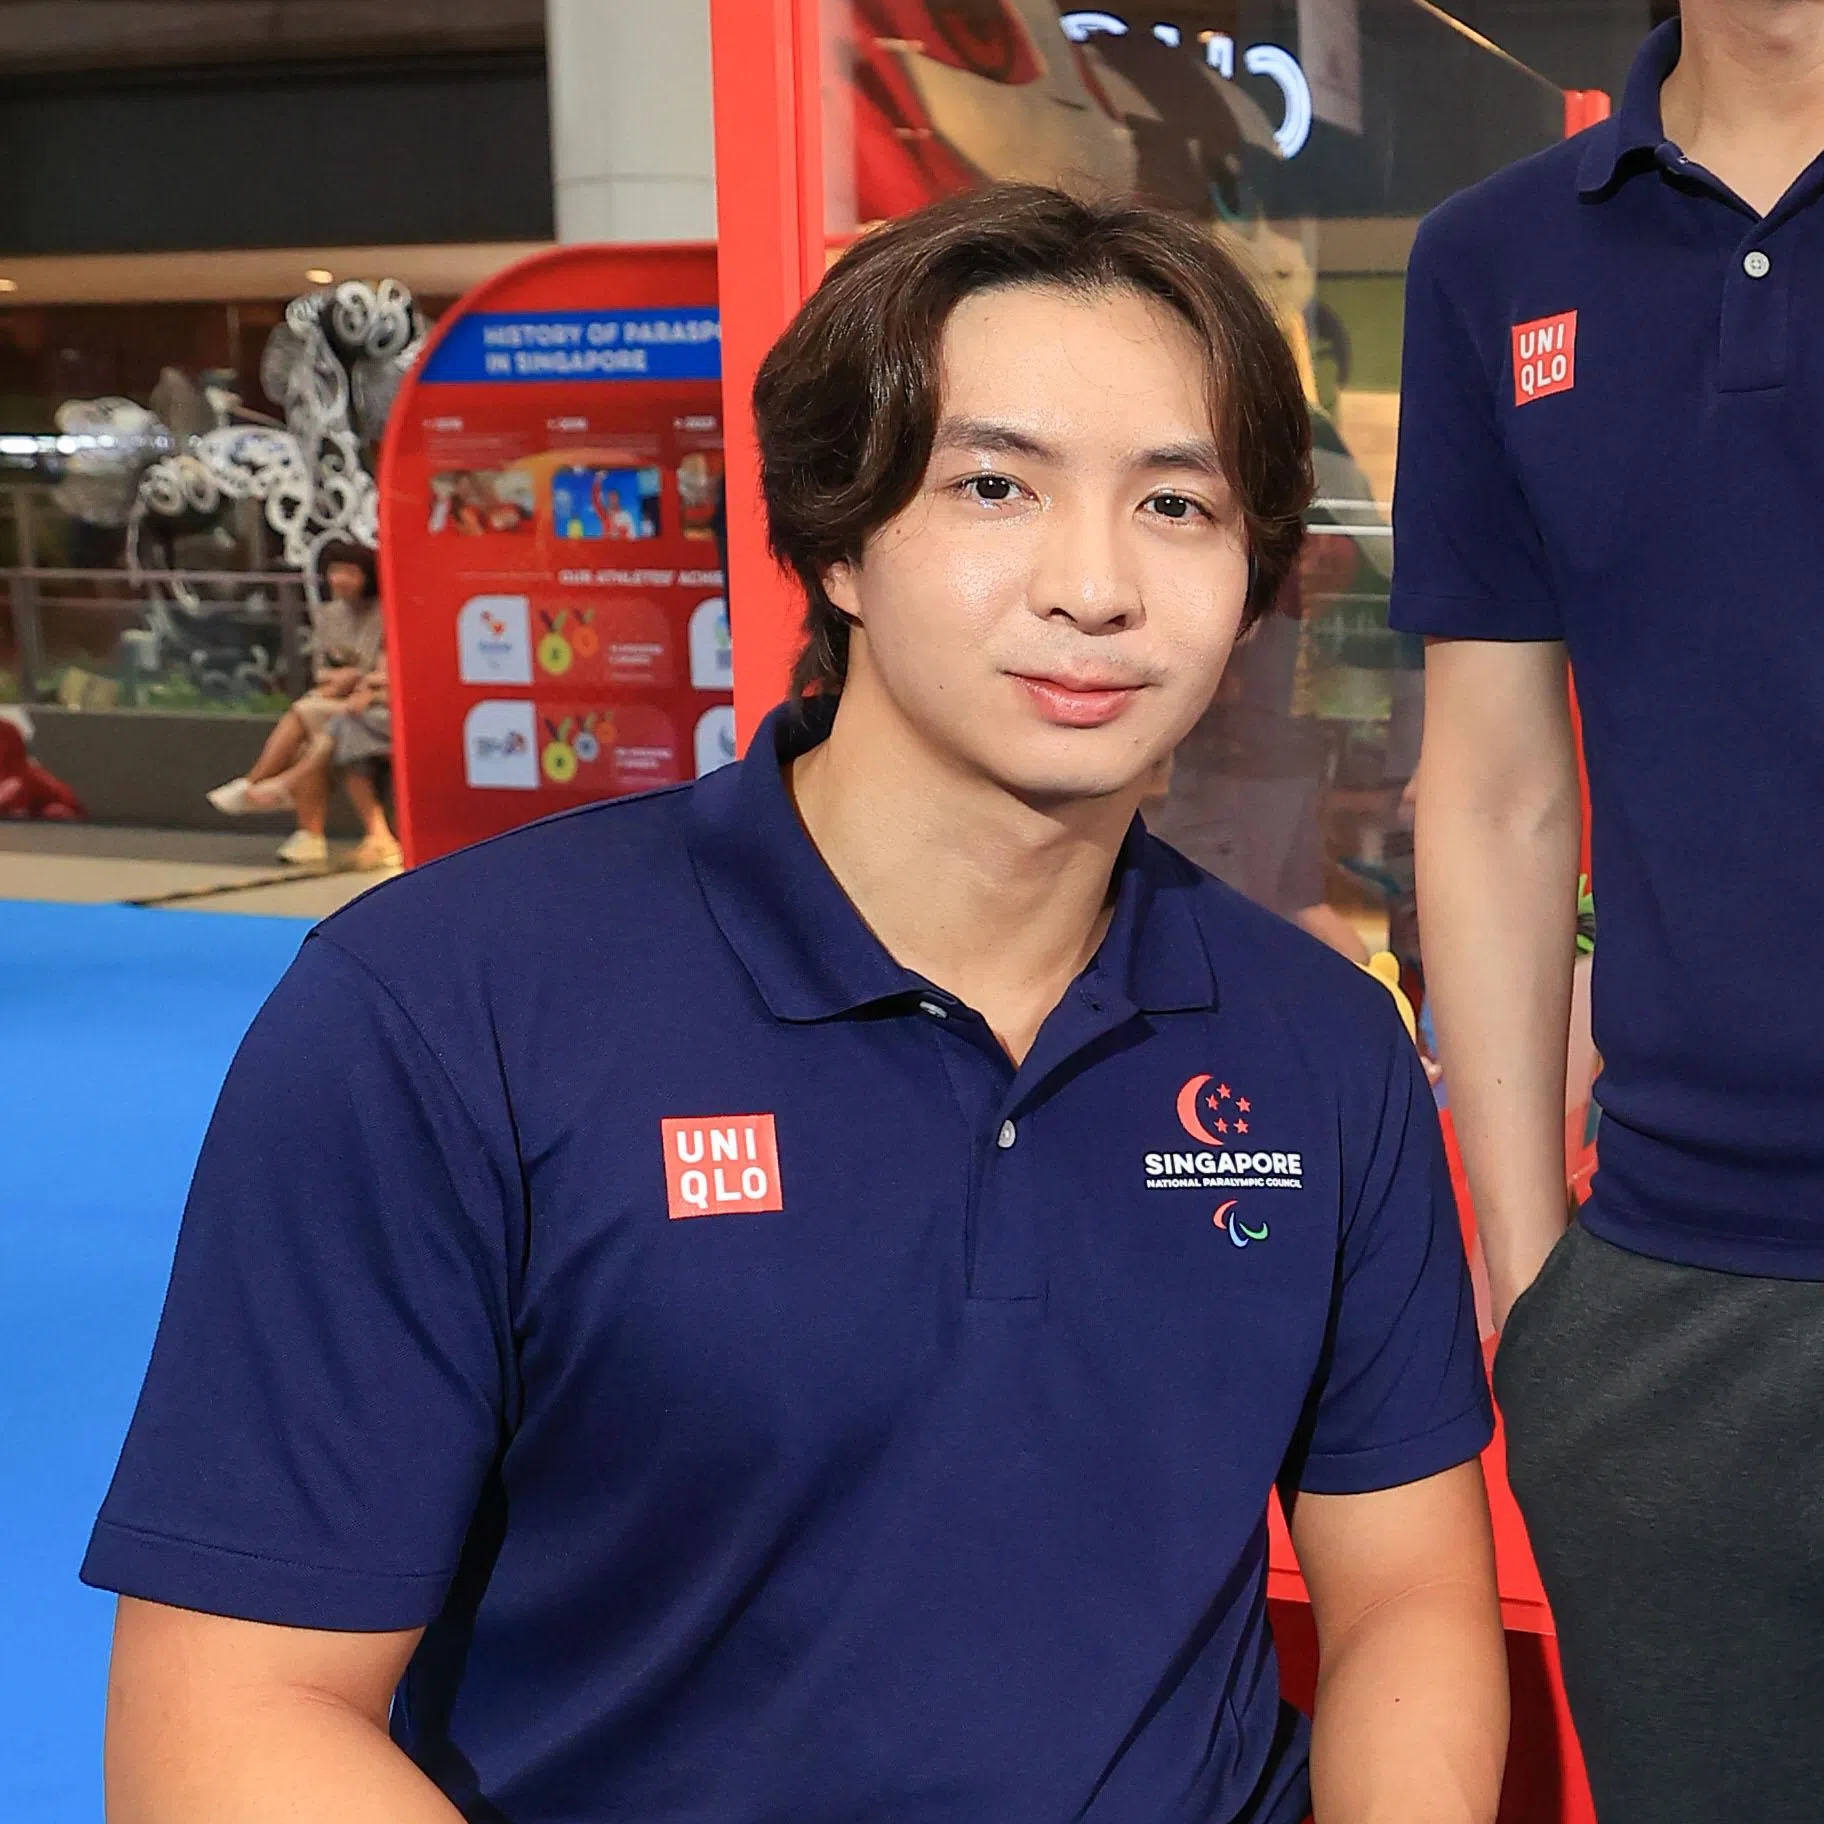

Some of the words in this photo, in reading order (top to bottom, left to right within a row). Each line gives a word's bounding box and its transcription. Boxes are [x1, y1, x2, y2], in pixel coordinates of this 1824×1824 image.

[483, 324, 583, 347] HISTORY
[586, 322, 619, 345] OF
[623, 320, 720, 344] PARASP
[1520, 323, 1565, 360] UNI
[485, 351, 511, 374] IN
[514, 348, 648, 373] SINGAPORE
[1521, 354, 1567, 396] QLO
[676, 1127, 757, 1164] UNI
[1144, 1152, 1303, 1176] SINGAPORE
[680, 1166, 768, 1209] QLO
[1146, 1178, 1202, 1189] NATIONAL
[1202, 1177, 1265, 1188] PARALYMPIC
[1265, 1178, 1303, 1189] COUNCIL
